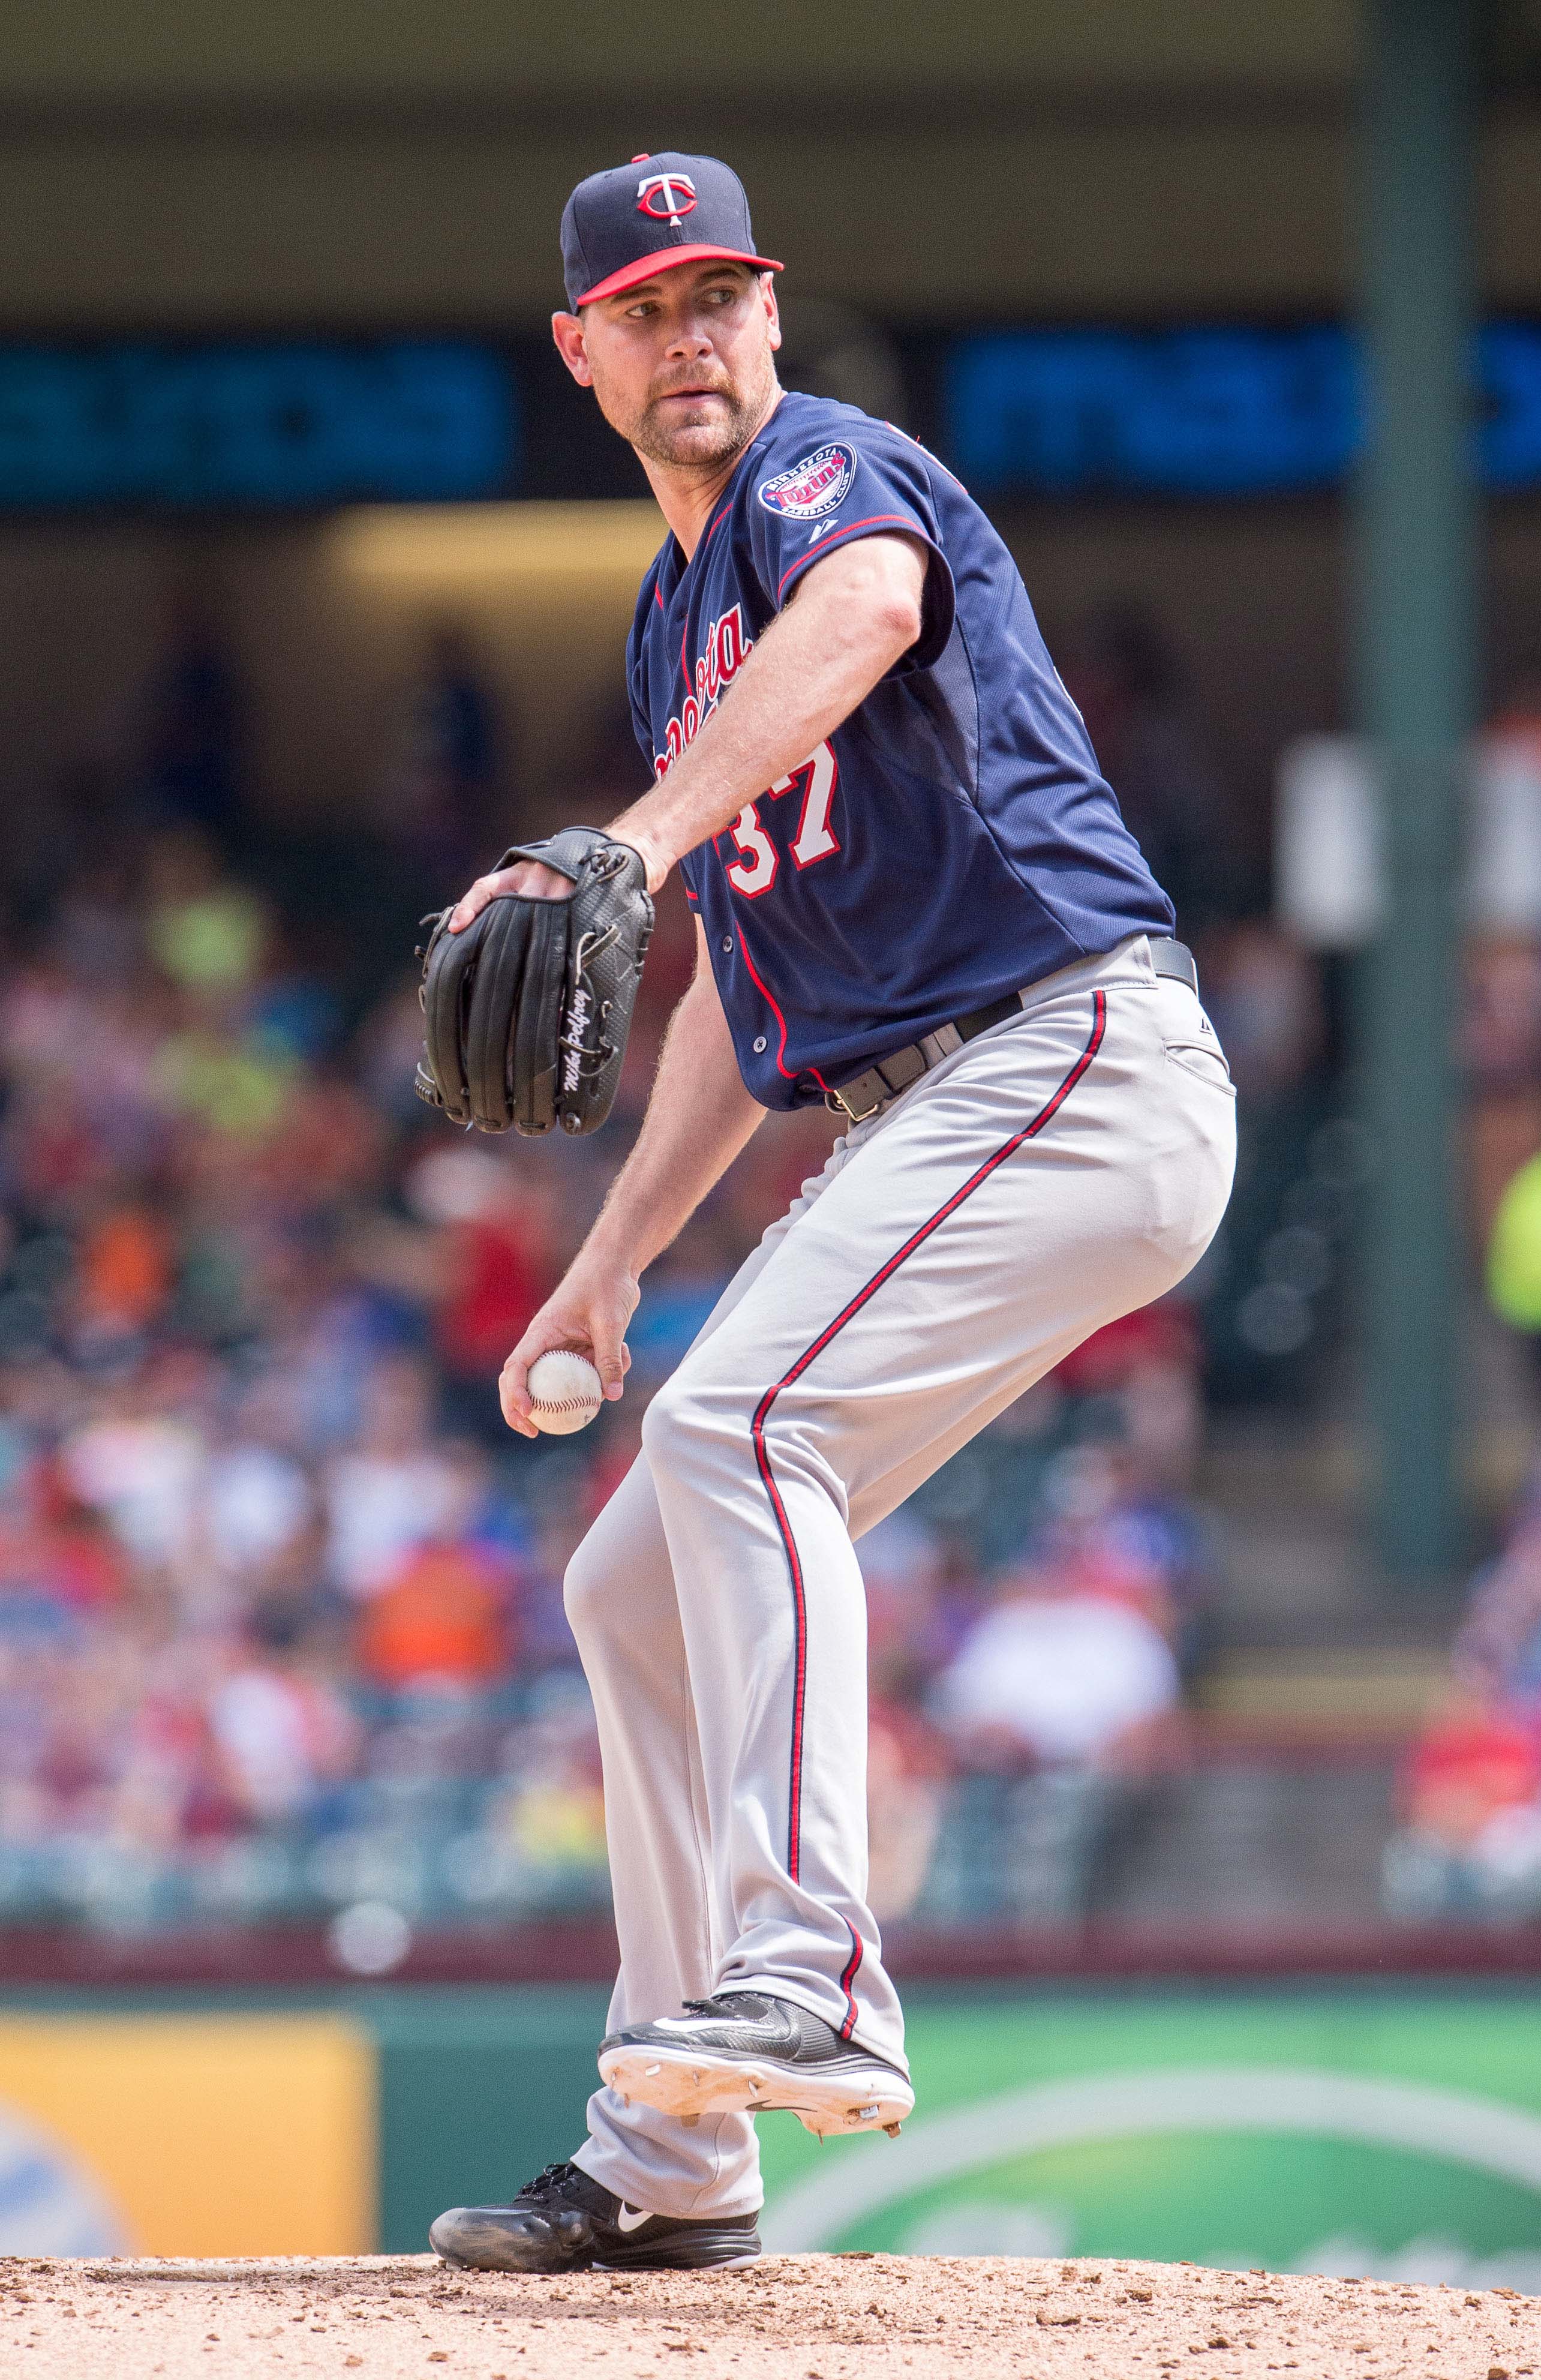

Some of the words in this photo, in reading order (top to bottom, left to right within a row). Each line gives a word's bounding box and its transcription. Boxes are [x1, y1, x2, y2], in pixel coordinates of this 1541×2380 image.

[767, 448, 836, 491] MINNESOTA
[782, 500, 836, 516] BASEBALL
[837, 472, 850, 497] CLUB
[724, 739, 840, 901] 37
